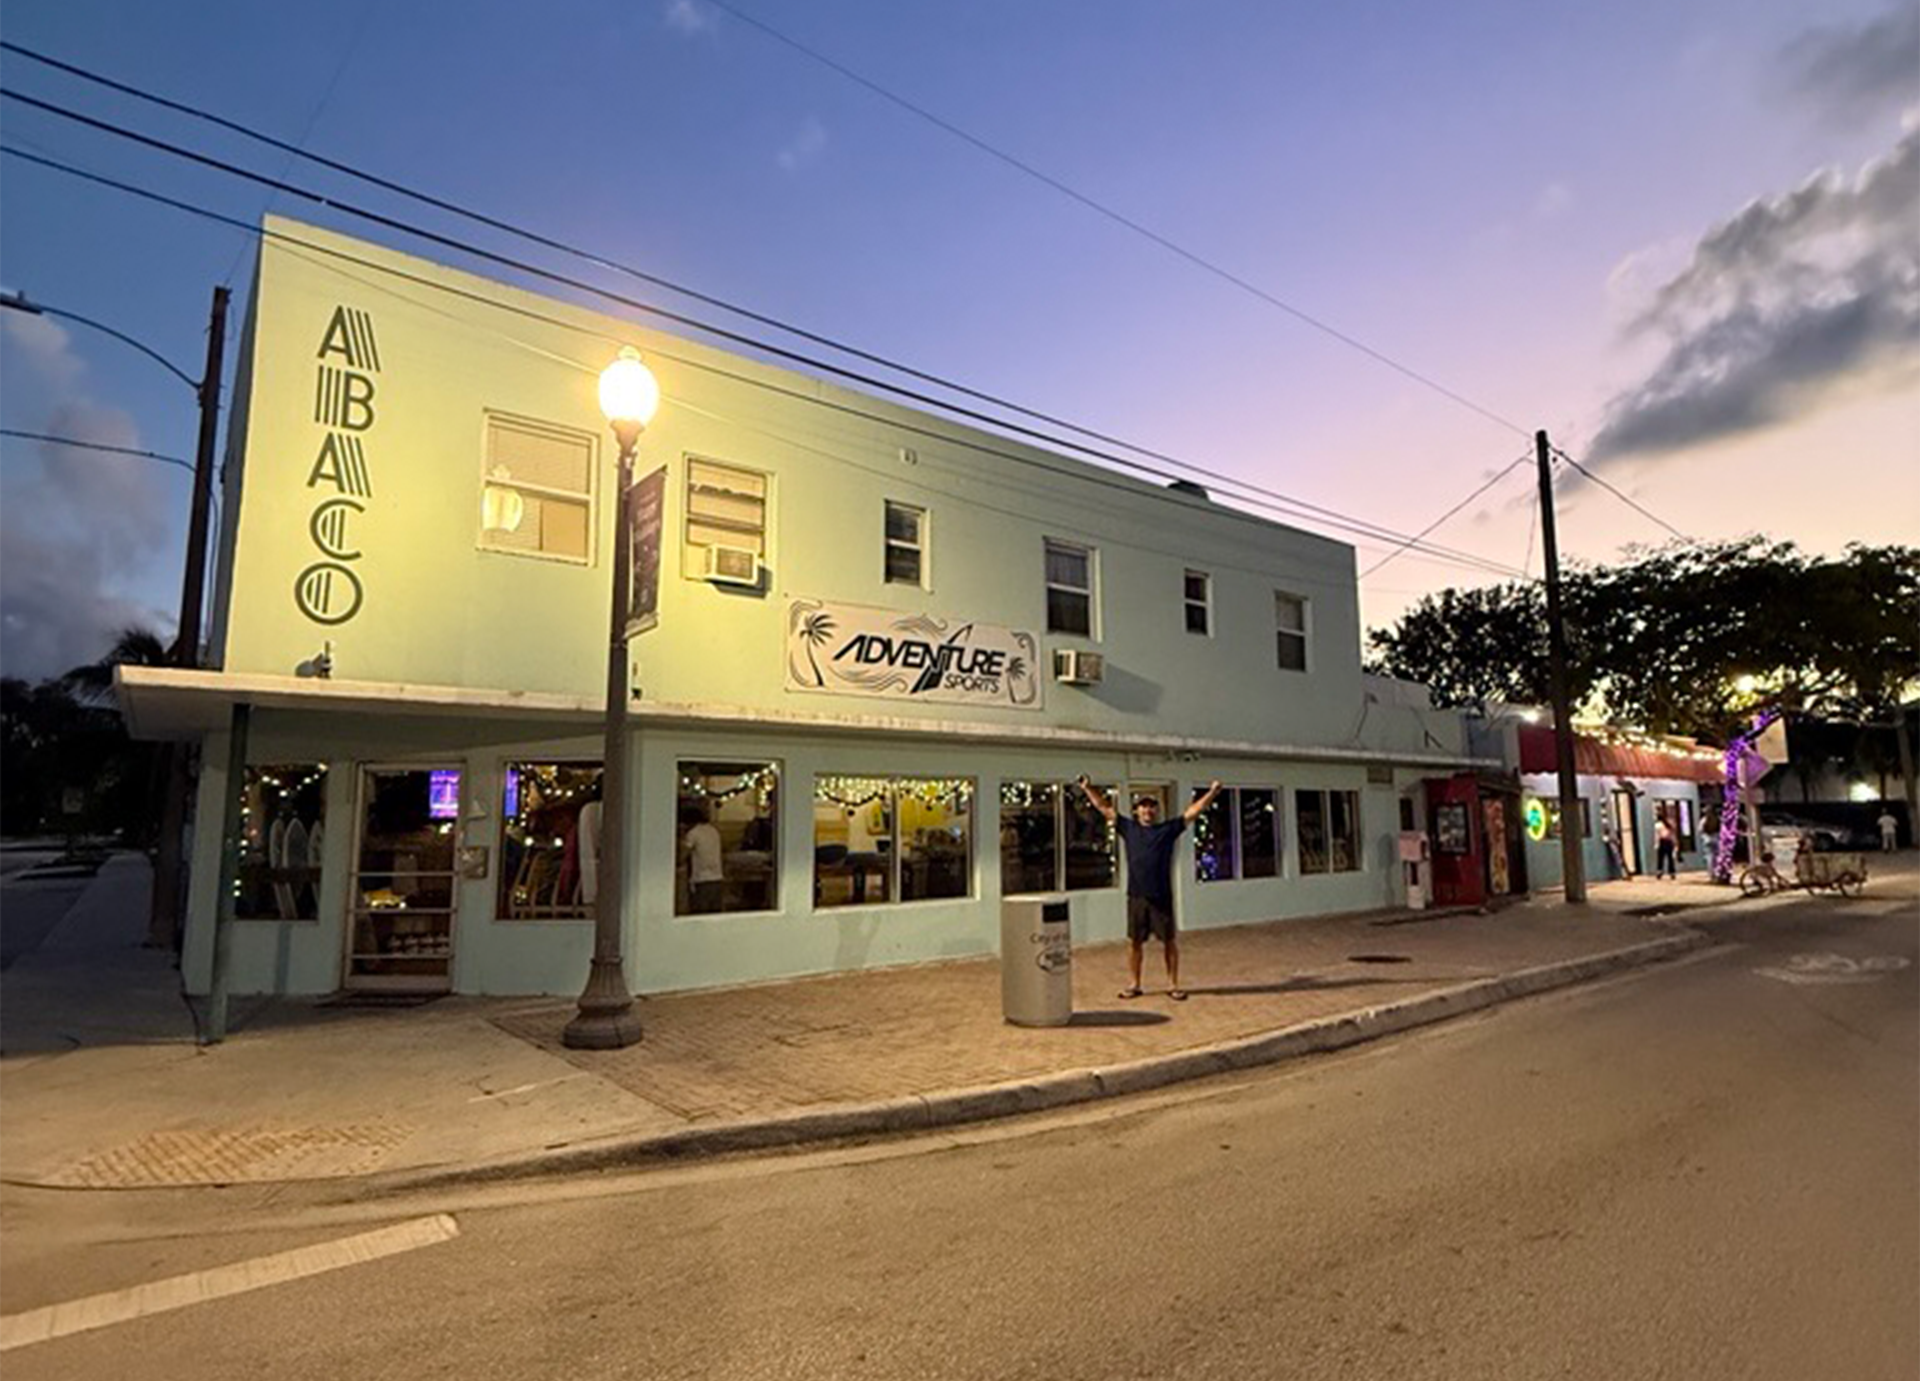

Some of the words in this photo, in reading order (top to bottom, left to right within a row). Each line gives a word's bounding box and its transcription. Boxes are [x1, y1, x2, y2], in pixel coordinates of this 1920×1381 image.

[294, 305, 380, 625] ABACO
[833, 634, 1006, 677] ADVENTURE
[944, 674, 1000, 693] SPORTS
